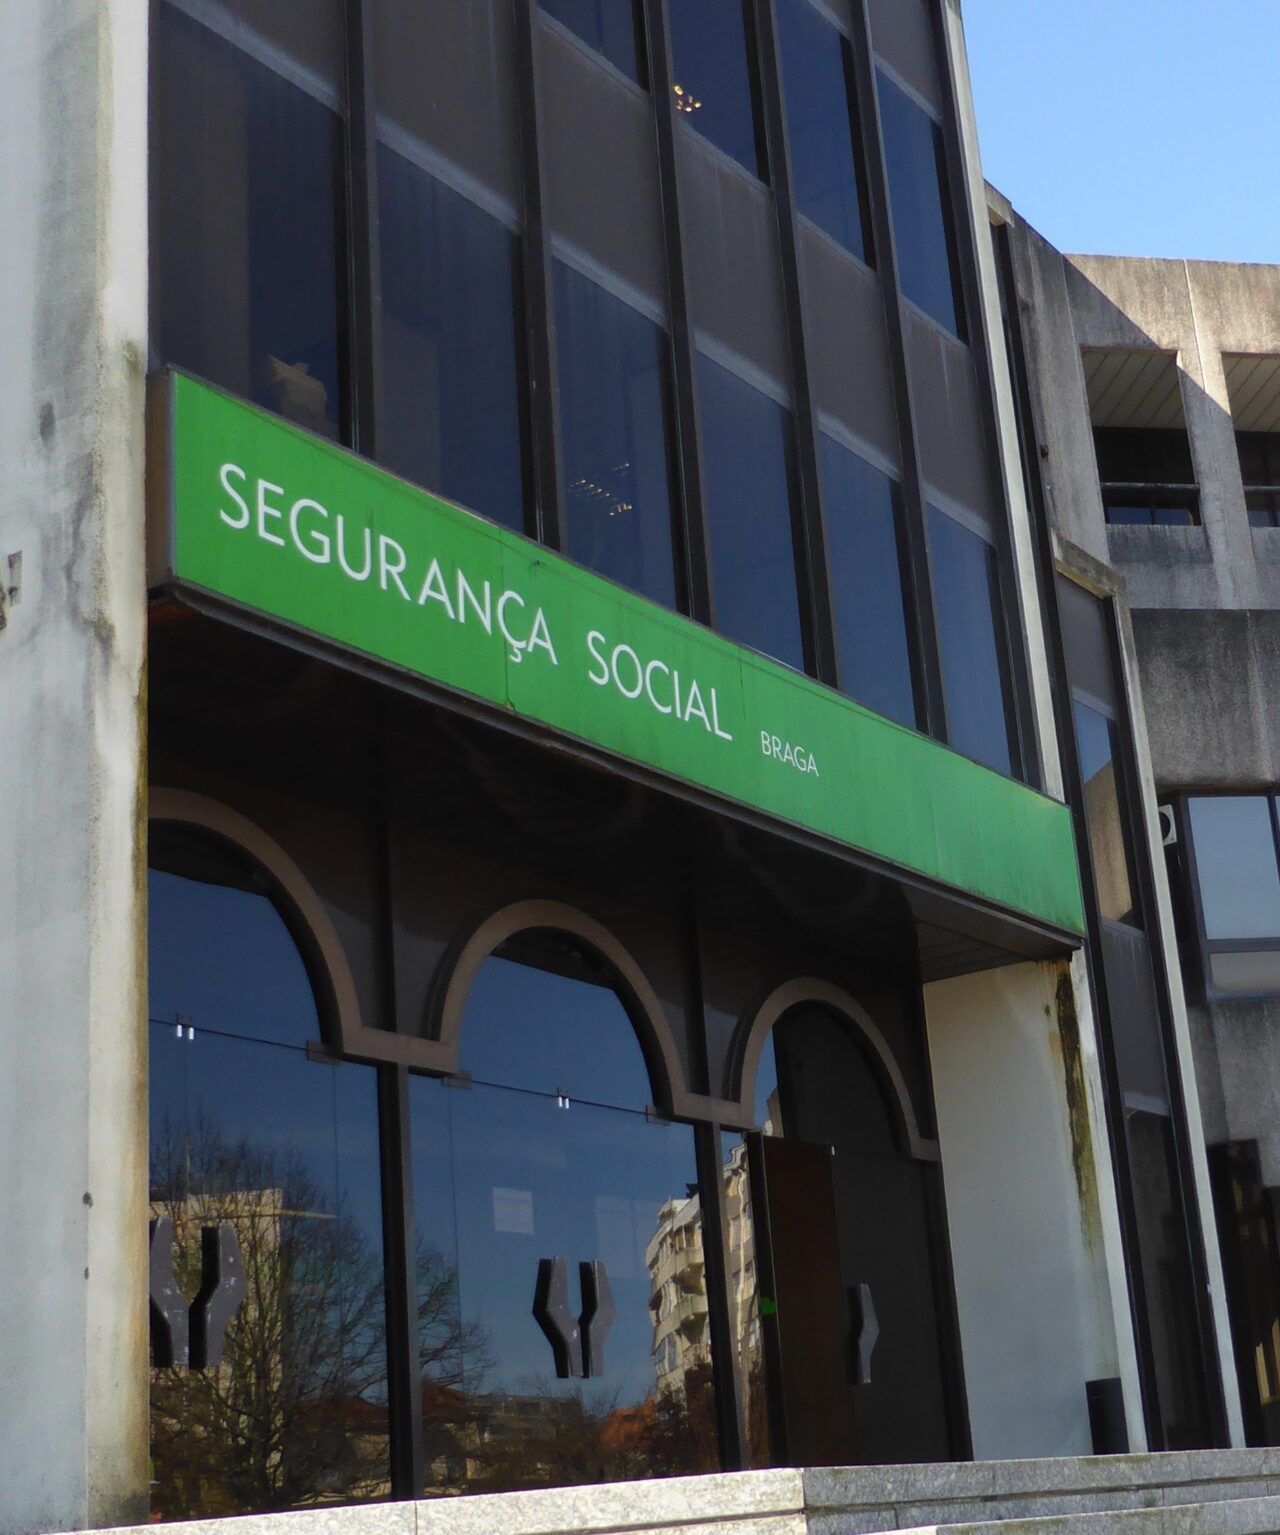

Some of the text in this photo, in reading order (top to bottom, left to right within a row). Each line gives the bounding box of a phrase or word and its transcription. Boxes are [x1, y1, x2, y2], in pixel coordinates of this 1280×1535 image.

[219, 462, 820, 778] SEGURANÇA SOCIAL BRAGA
